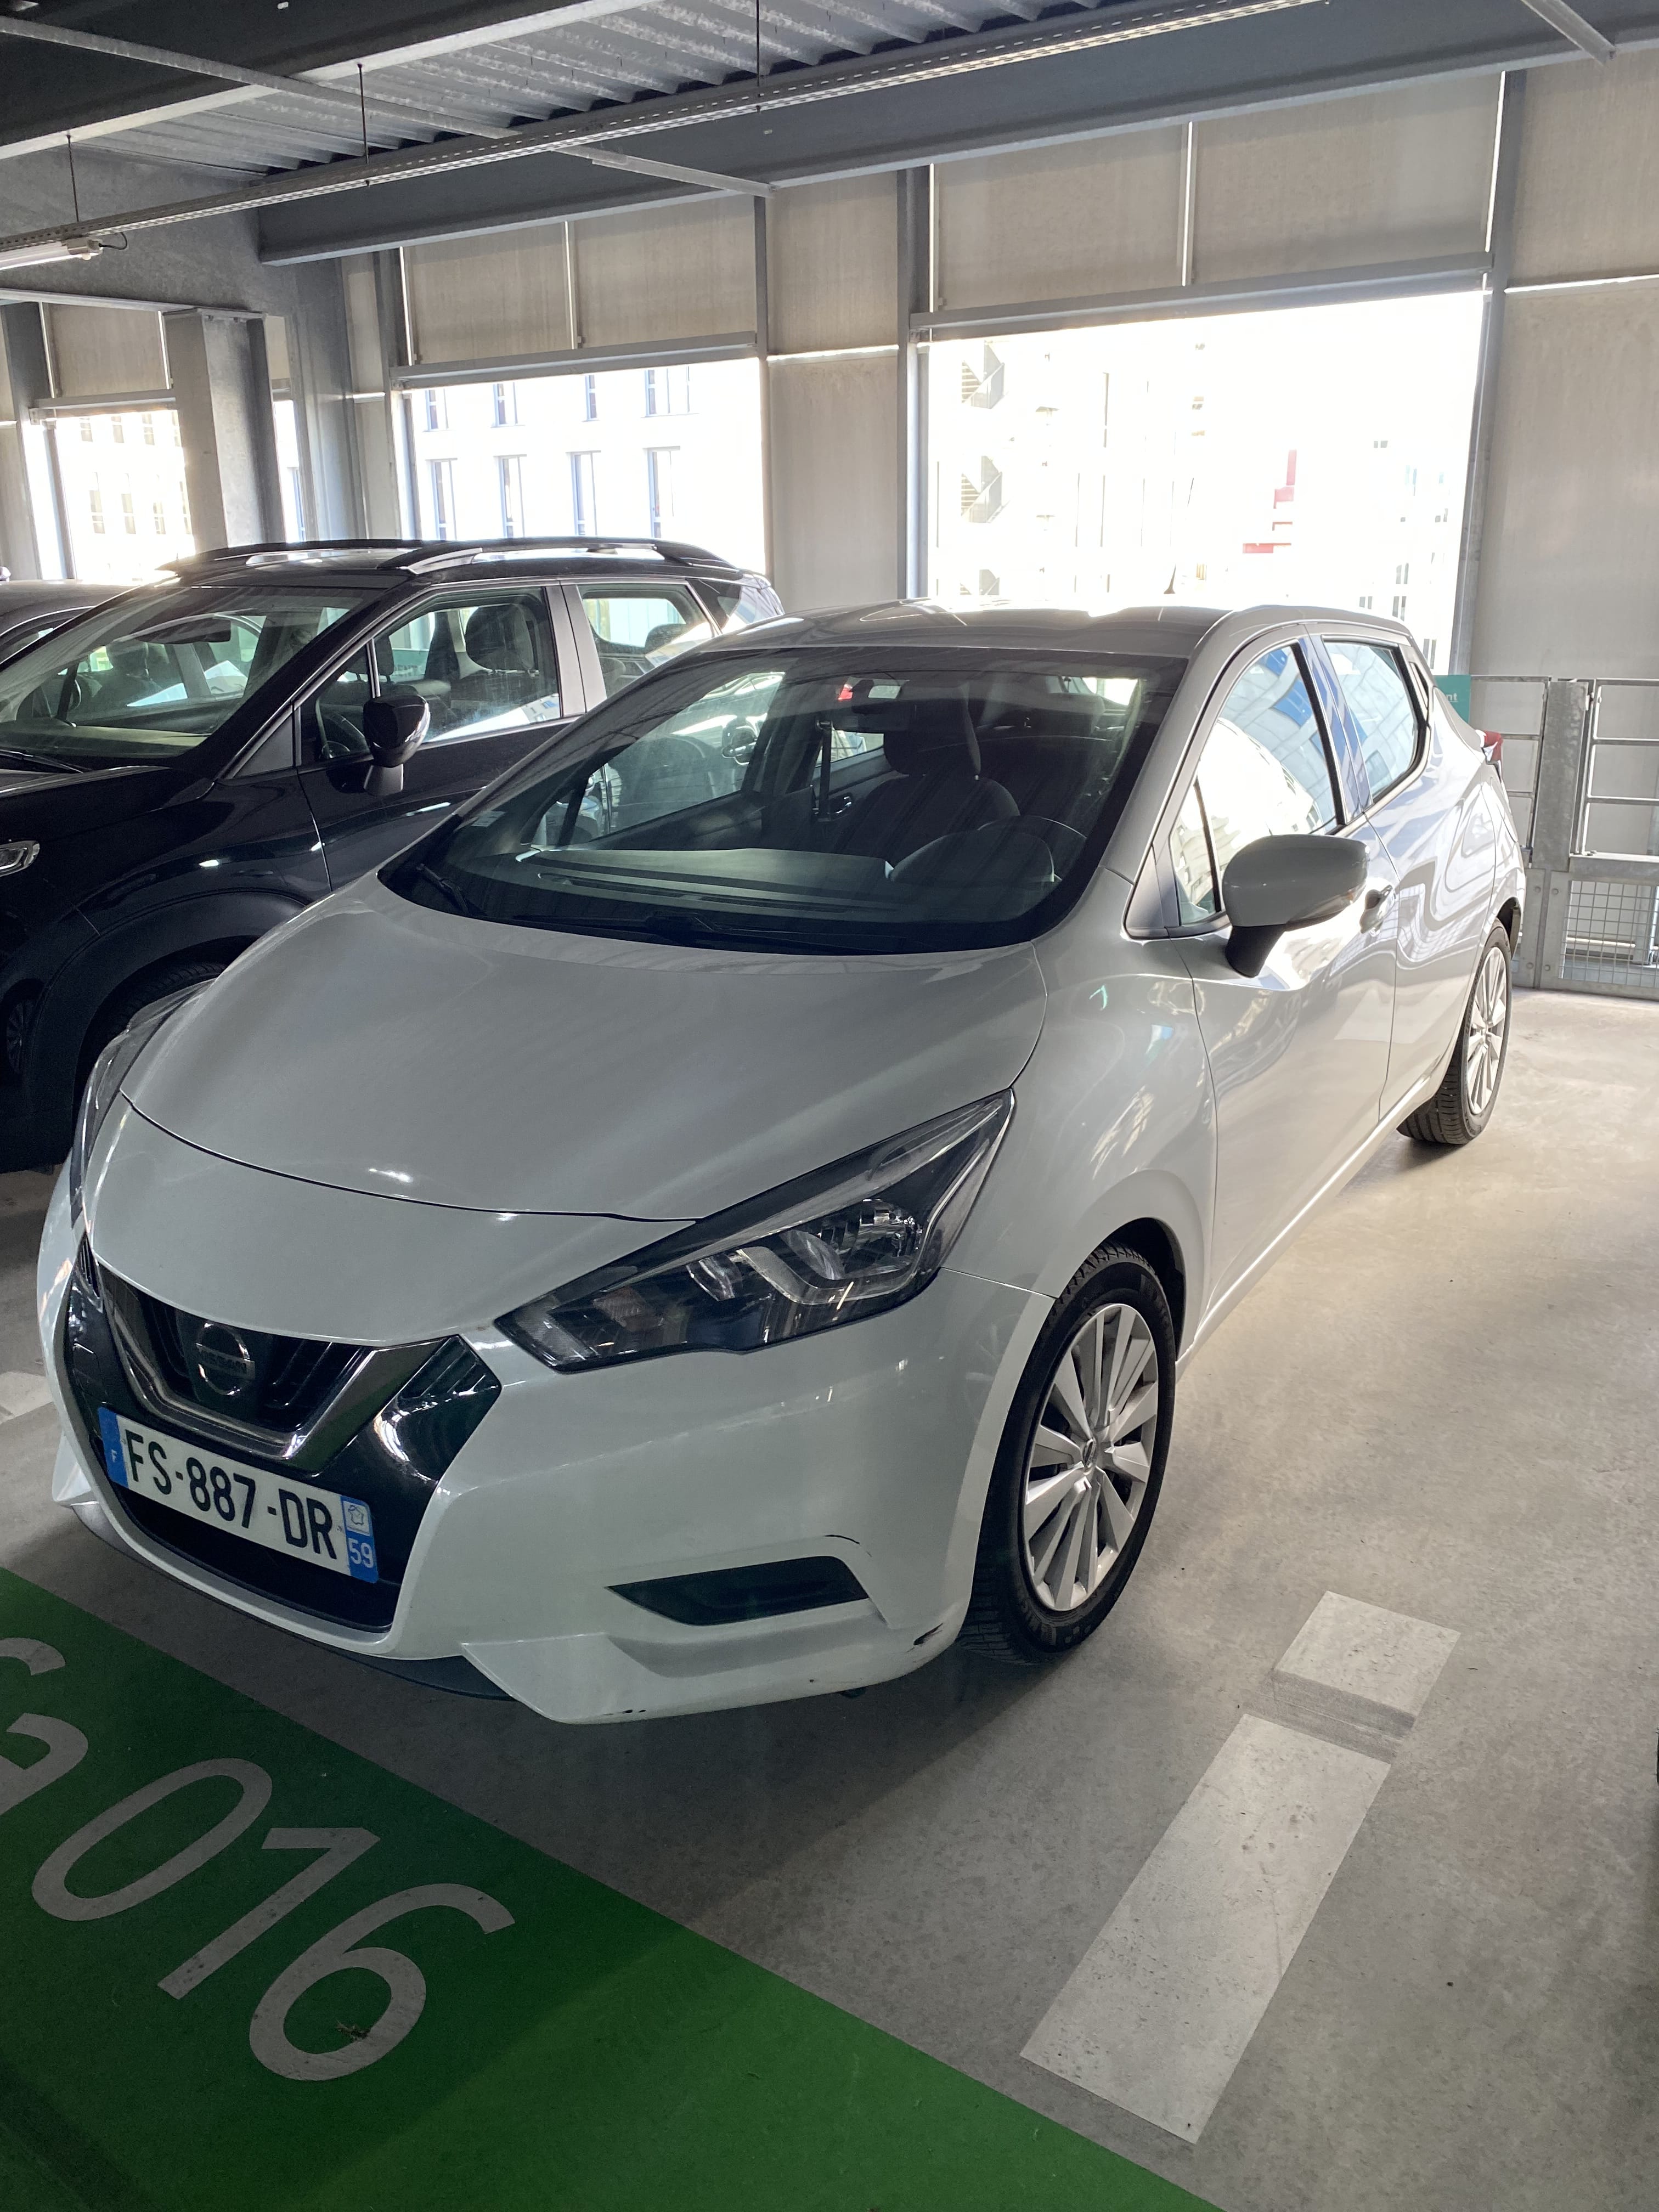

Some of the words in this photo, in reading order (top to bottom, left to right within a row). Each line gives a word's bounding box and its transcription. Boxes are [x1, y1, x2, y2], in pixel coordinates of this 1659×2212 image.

[111, 1449, 117, 1463] F
[125, 1429, 337, 1560] FS-887-DR
[348, 1537, 374, 1568] 59
